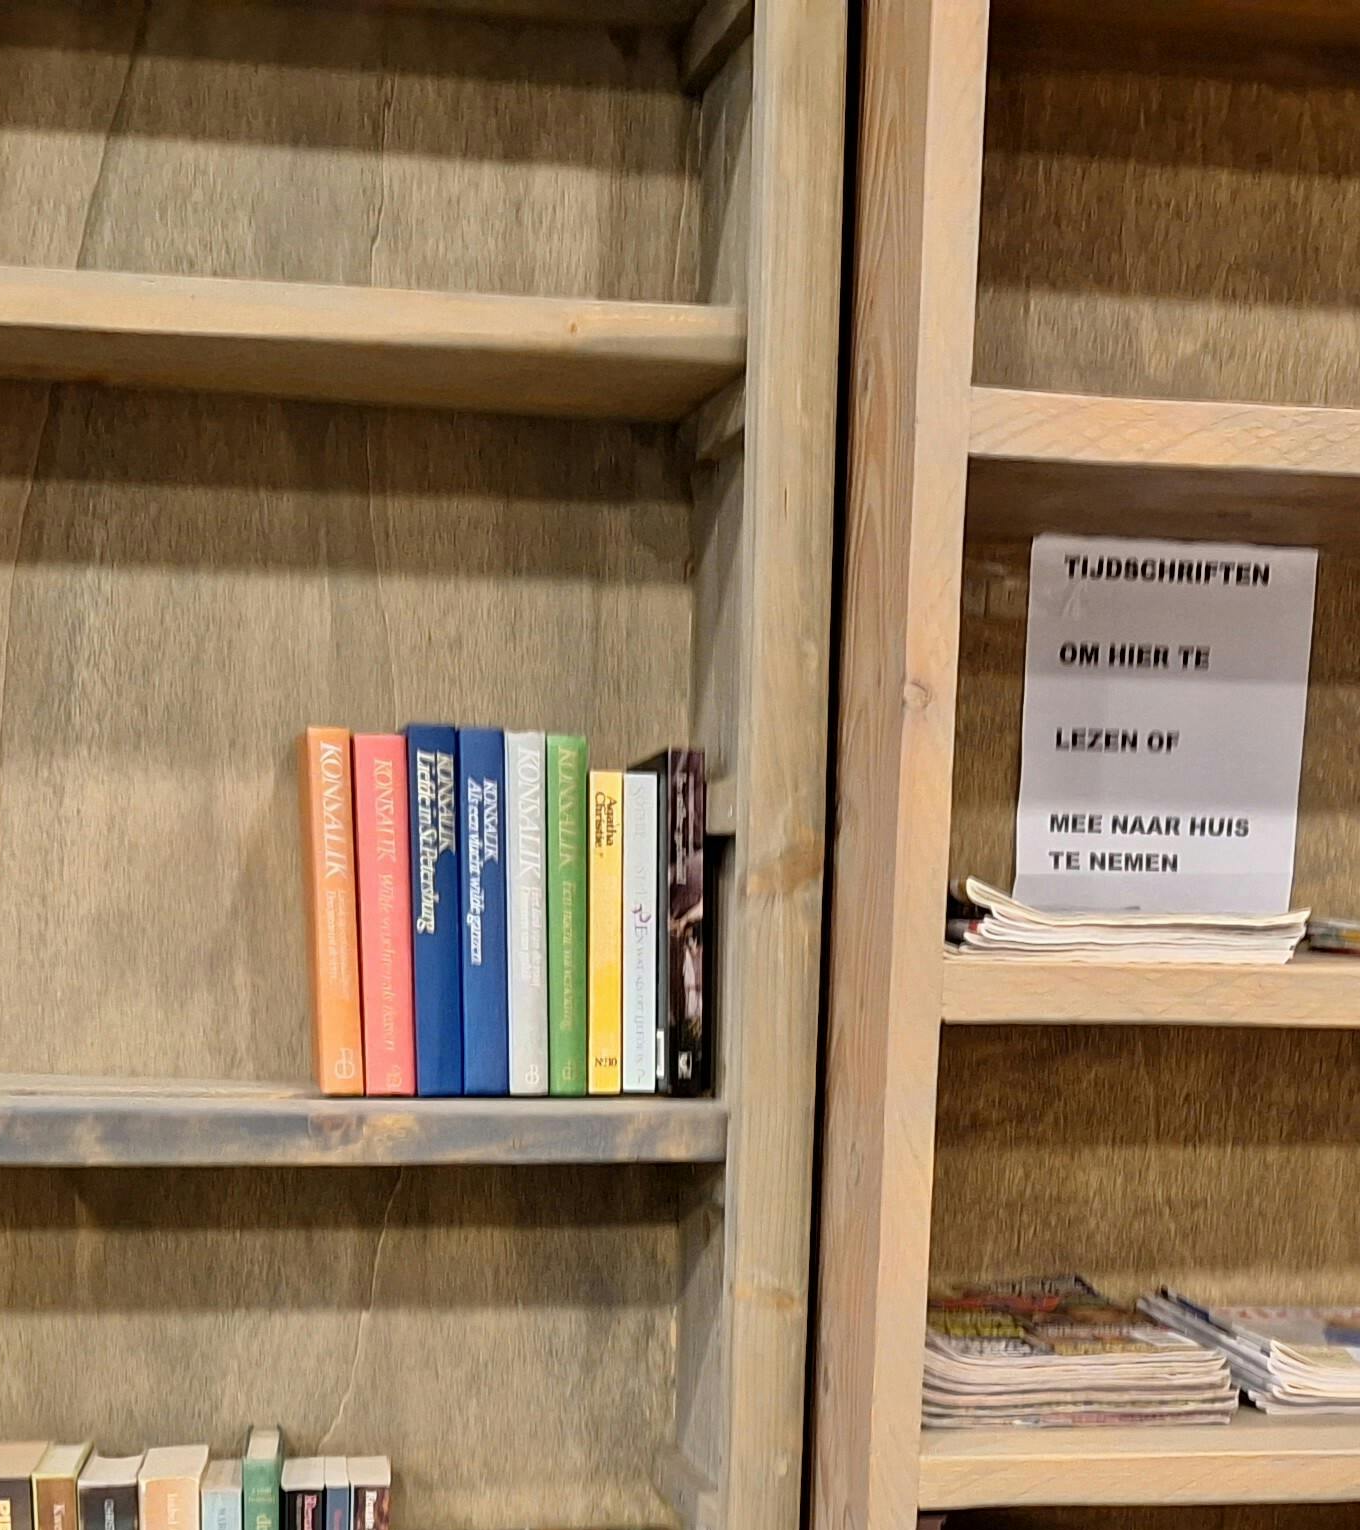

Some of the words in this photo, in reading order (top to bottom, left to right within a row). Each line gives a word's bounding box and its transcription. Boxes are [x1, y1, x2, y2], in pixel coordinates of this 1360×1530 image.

[1064, 554, 1270, 586] TIJDSCHRIFTEN
[1060, 642, 1099, 667] OM
[1109, 643, 1168, 669] HIER
[1179, 646, 1210, 671] TE
[1056, 728, 1138, 752] LEZEN
[1147, 730, 1179, 754] OF
[417, 751, 437, 802] Liefde
[320, 742, 346, 879] KONSALIK
[374, 759, 396, 862] KONSALIK
[437, 752, 455, 855] KONSALIK
[484, 779, 498, 863] KONSALIK
[518, 747, 540, 879] KONSALIK
[557, 745, 579, 871] KONSALIK
[594, 792, 606, 848] Christie
[605, 796, 618, 846] Agatha
[1050, 814, 1102, 834] MEE
[1111, 815, 1180, 836] NAAR
[1190, 817, 1249, 837] HUIS
[1049, 852, 1080, 870] TE
[1090, 853, 1178, 872] NEMEN
[167, 1493, 178, 1525] Isabel
[364, 1491, 377, 1529] Renate
